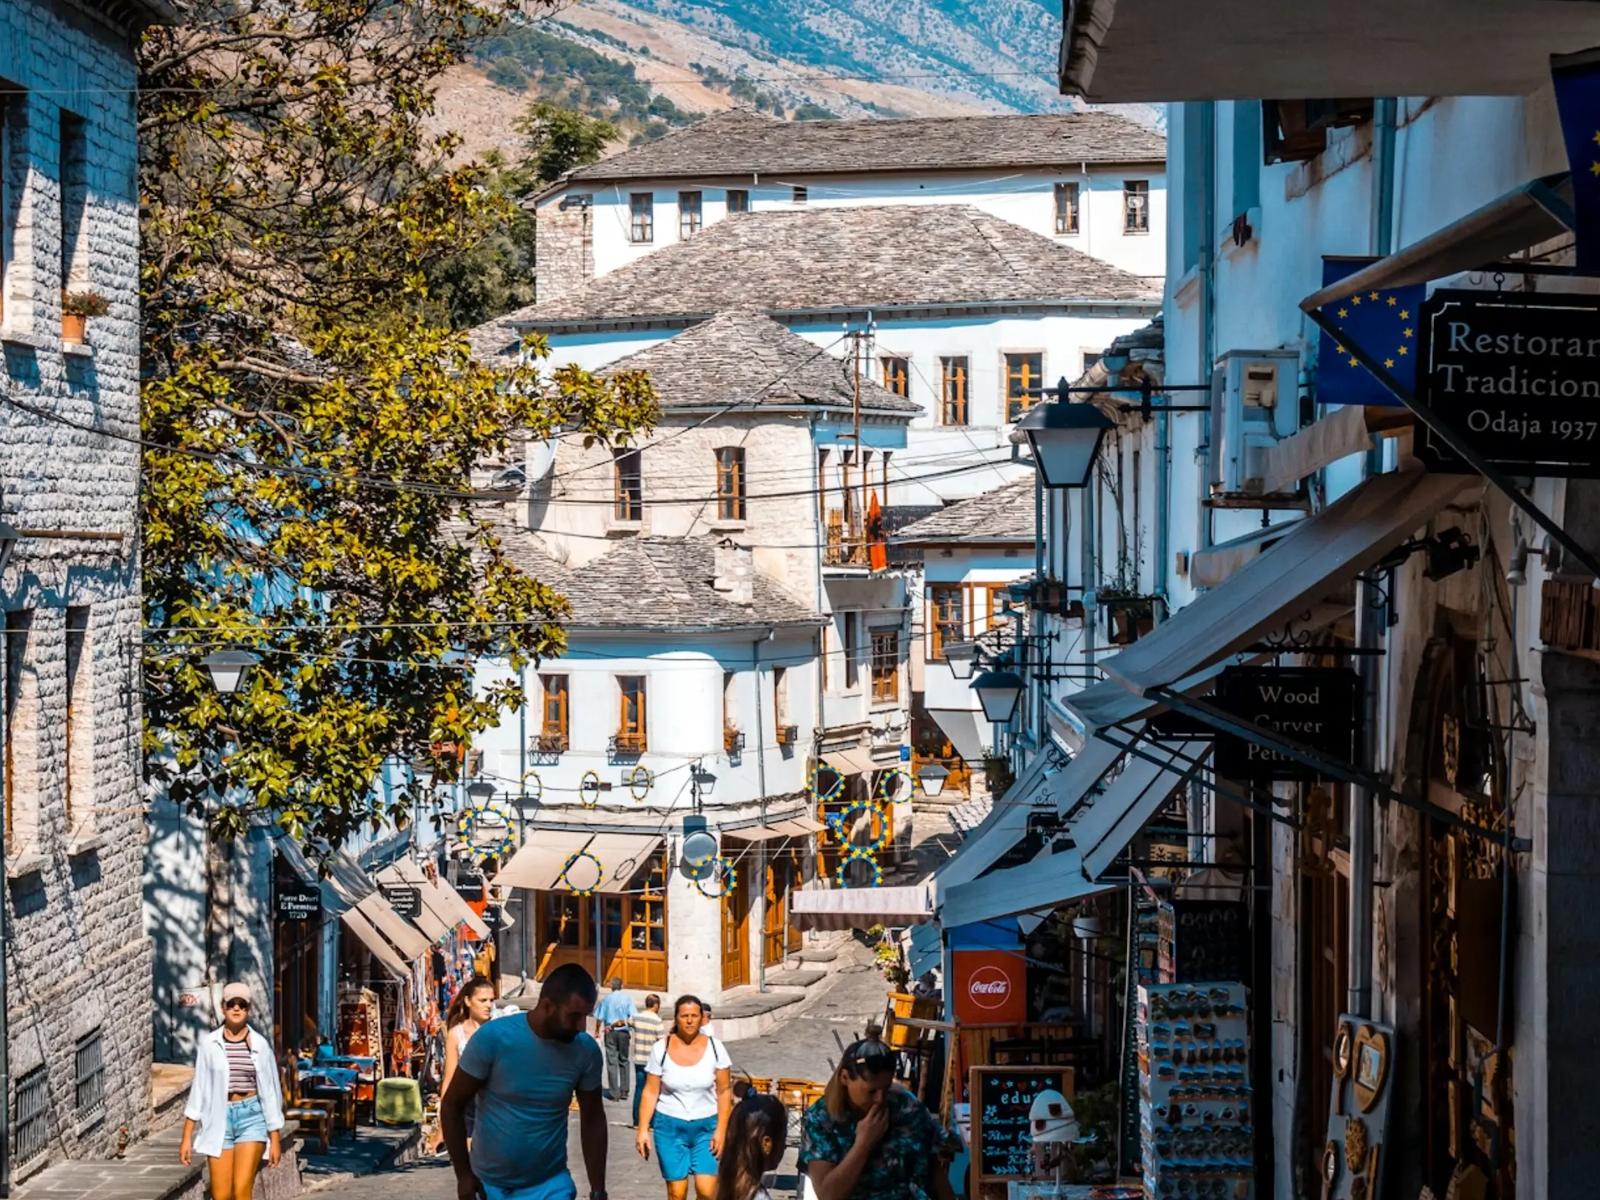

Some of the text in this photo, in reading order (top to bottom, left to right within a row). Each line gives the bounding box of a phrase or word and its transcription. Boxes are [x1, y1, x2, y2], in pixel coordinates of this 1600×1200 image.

[1437, 363, 1600, 398] Tradicion
[1467, 409, 1598, 441] Odaja 1937
[1258, 685, 1320, 704] Wood
